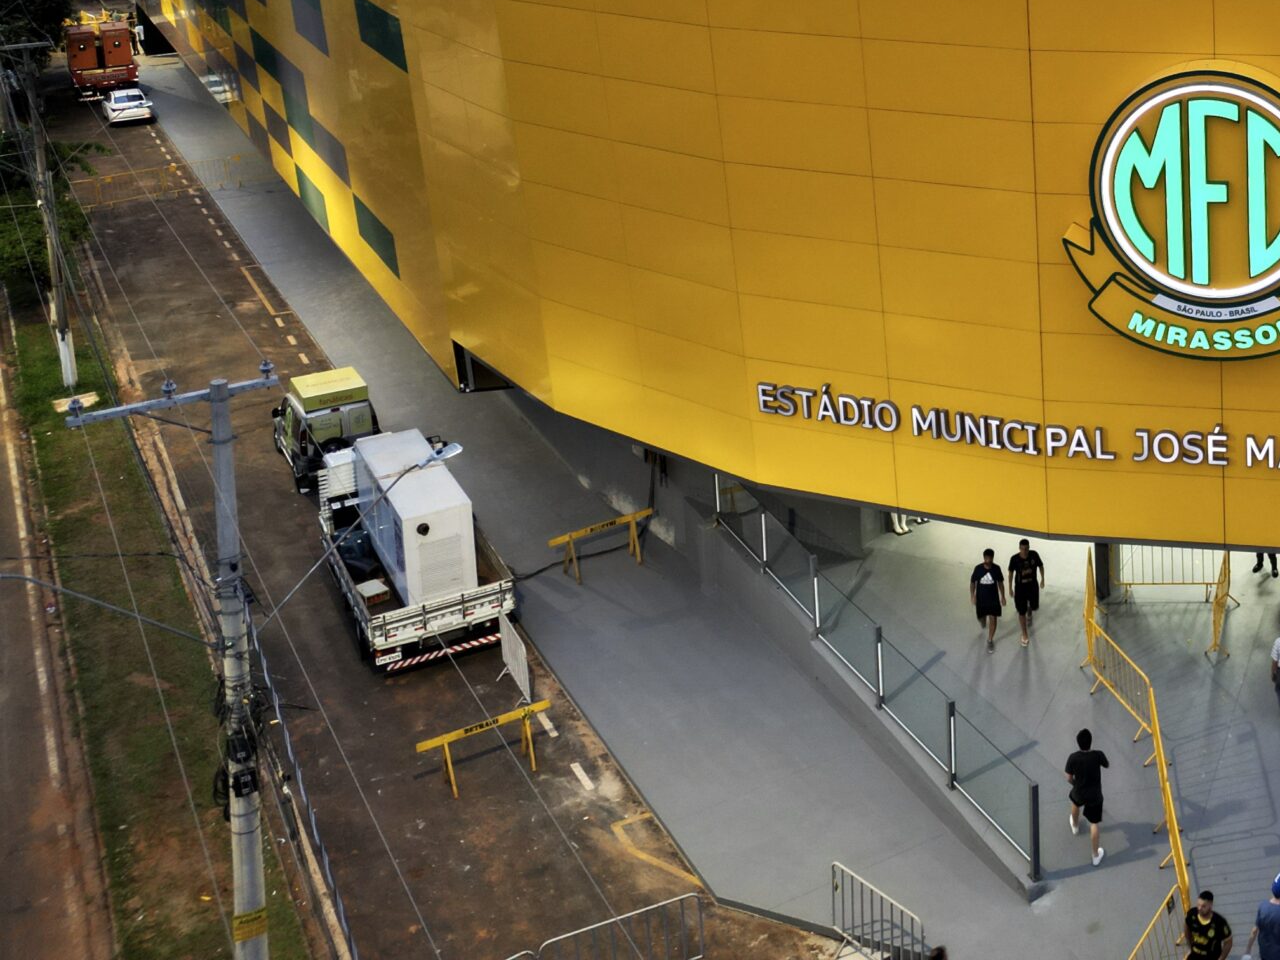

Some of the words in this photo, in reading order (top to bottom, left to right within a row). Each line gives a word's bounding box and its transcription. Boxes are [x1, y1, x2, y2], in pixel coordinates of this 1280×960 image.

[1176, 304, 1194, 315] SÃO
[1195, 307, 1223, 318] PAULO
[1228, 306, 1259, 318] BRASIL
[756, 382, 901, 432] ESTÁDIO
[911, 405, 1117, 460] MUNICIPAL
[1132, 422, 1230, 466] JOSÉ
